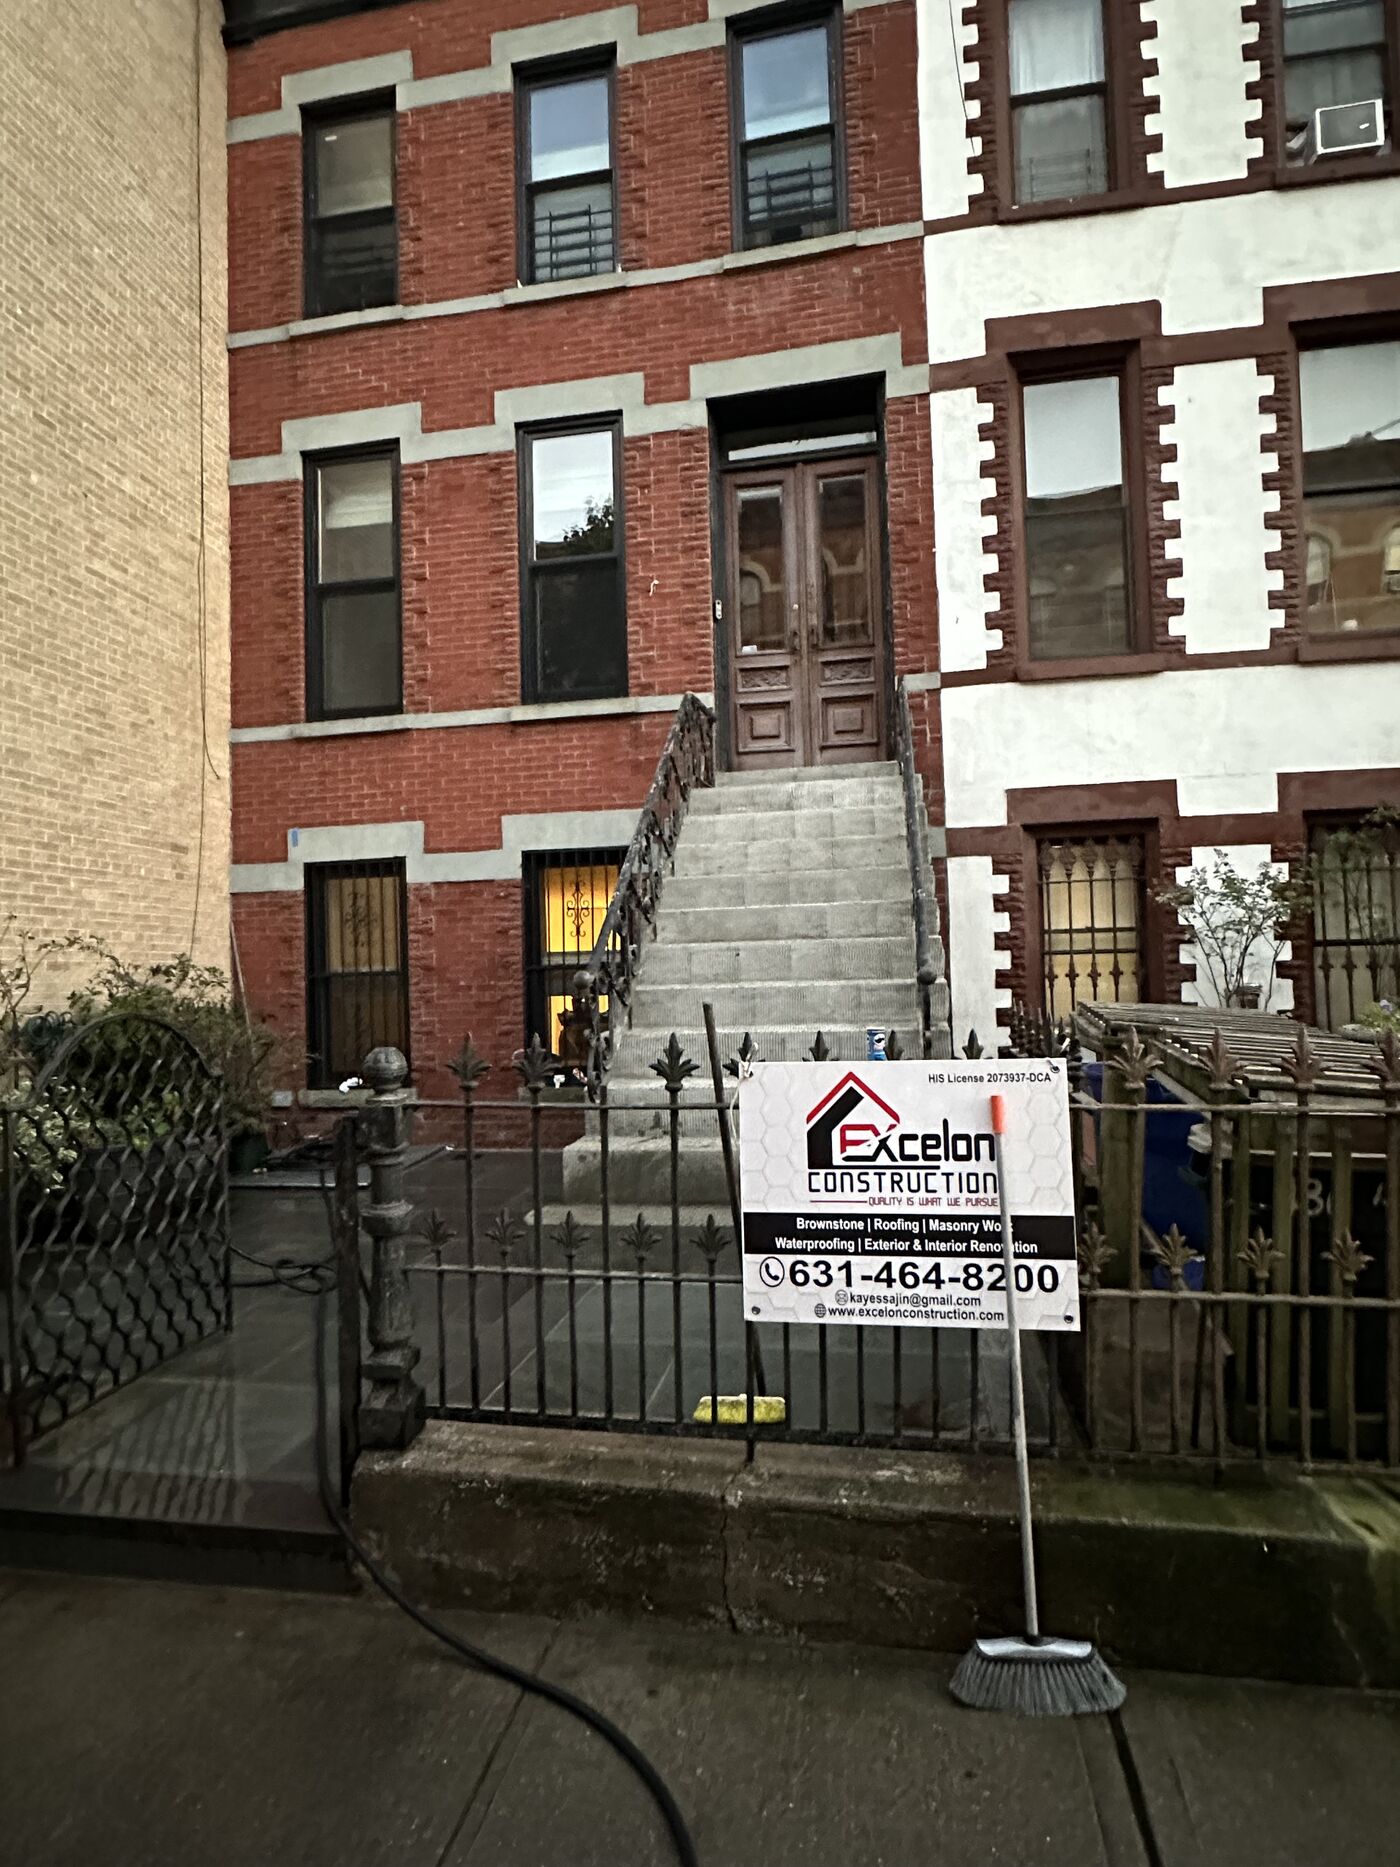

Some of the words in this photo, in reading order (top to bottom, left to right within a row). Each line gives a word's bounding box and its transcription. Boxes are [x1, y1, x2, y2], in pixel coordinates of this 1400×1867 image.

[928, 1073, 945, 1083] HIS
[947, 1073, 984, 1083] License
[987, 1072, 1051, 1083] 2073937-DCA
[868, 1196, 902, 1206] QUALITY
[906, 1196, 914, 1206] IS
[918, 1196, 941, 1206] WHAT
[947, 1197, 960, 1206] WE
[965, 1197, 998, 1207] PURSUE
[796, 1217, 865, 1230] Brownstone
[873, 1218, 919, 1233] Roofing
[929, 1219, 979, 1234] Masonry
[775, 1237, 855, 1252] Waterproofing
[864, 1238, 909, 1251] Exterior
[913, 1240, 922, 1250] &
[925, 1239, 967, 1252] Interior
[789, 1260, 1059, 1293] 631-464-8200
[849, 1292, 981, 1307] kayessajin@gmail.com
[828, 1306, 1004, 1321] www.excelonconstruction.com
